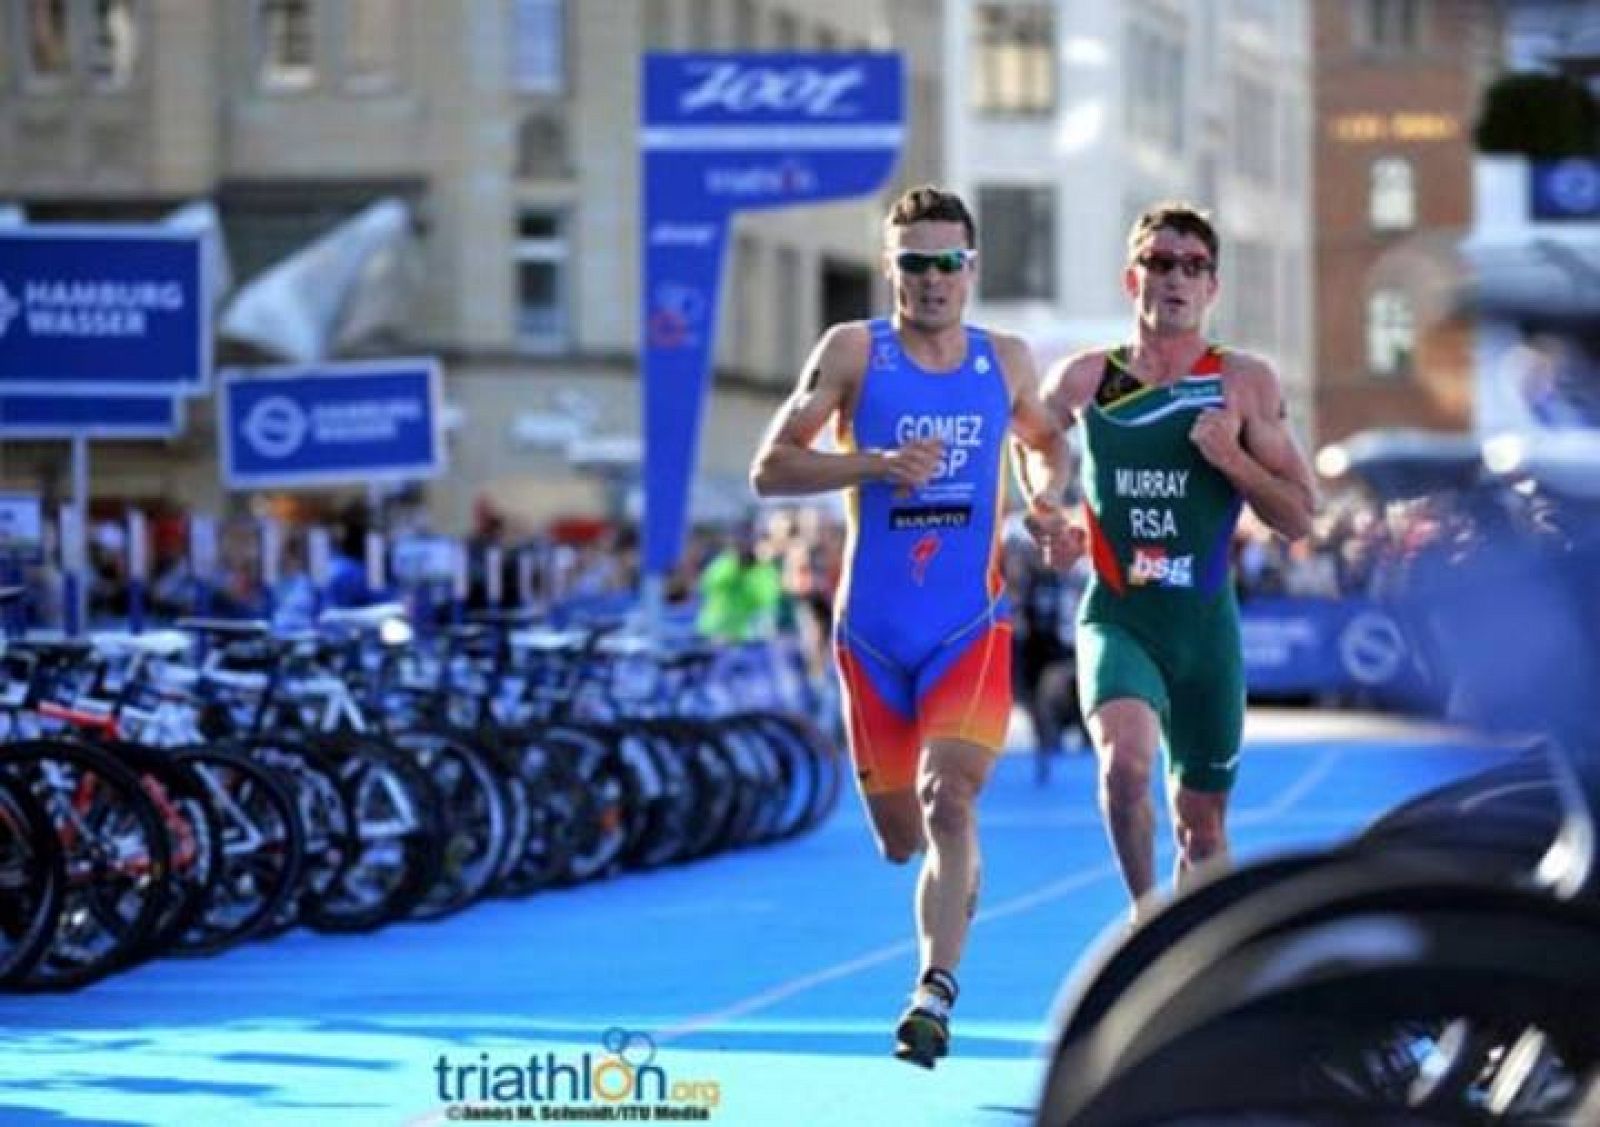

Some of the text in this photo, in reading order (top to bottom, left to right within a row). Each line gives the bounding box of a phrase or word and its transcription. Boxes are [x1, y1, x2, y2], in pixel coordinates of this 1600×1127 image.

[26, 281, 184, 311] HAMBURG
[28, 311, 146, 338] WASSER
[895, 414, 982, 447] GOMEZ
[1115, 468, 1190, 498] MURRAY
[1129, 508, 1178, 538] RSA
